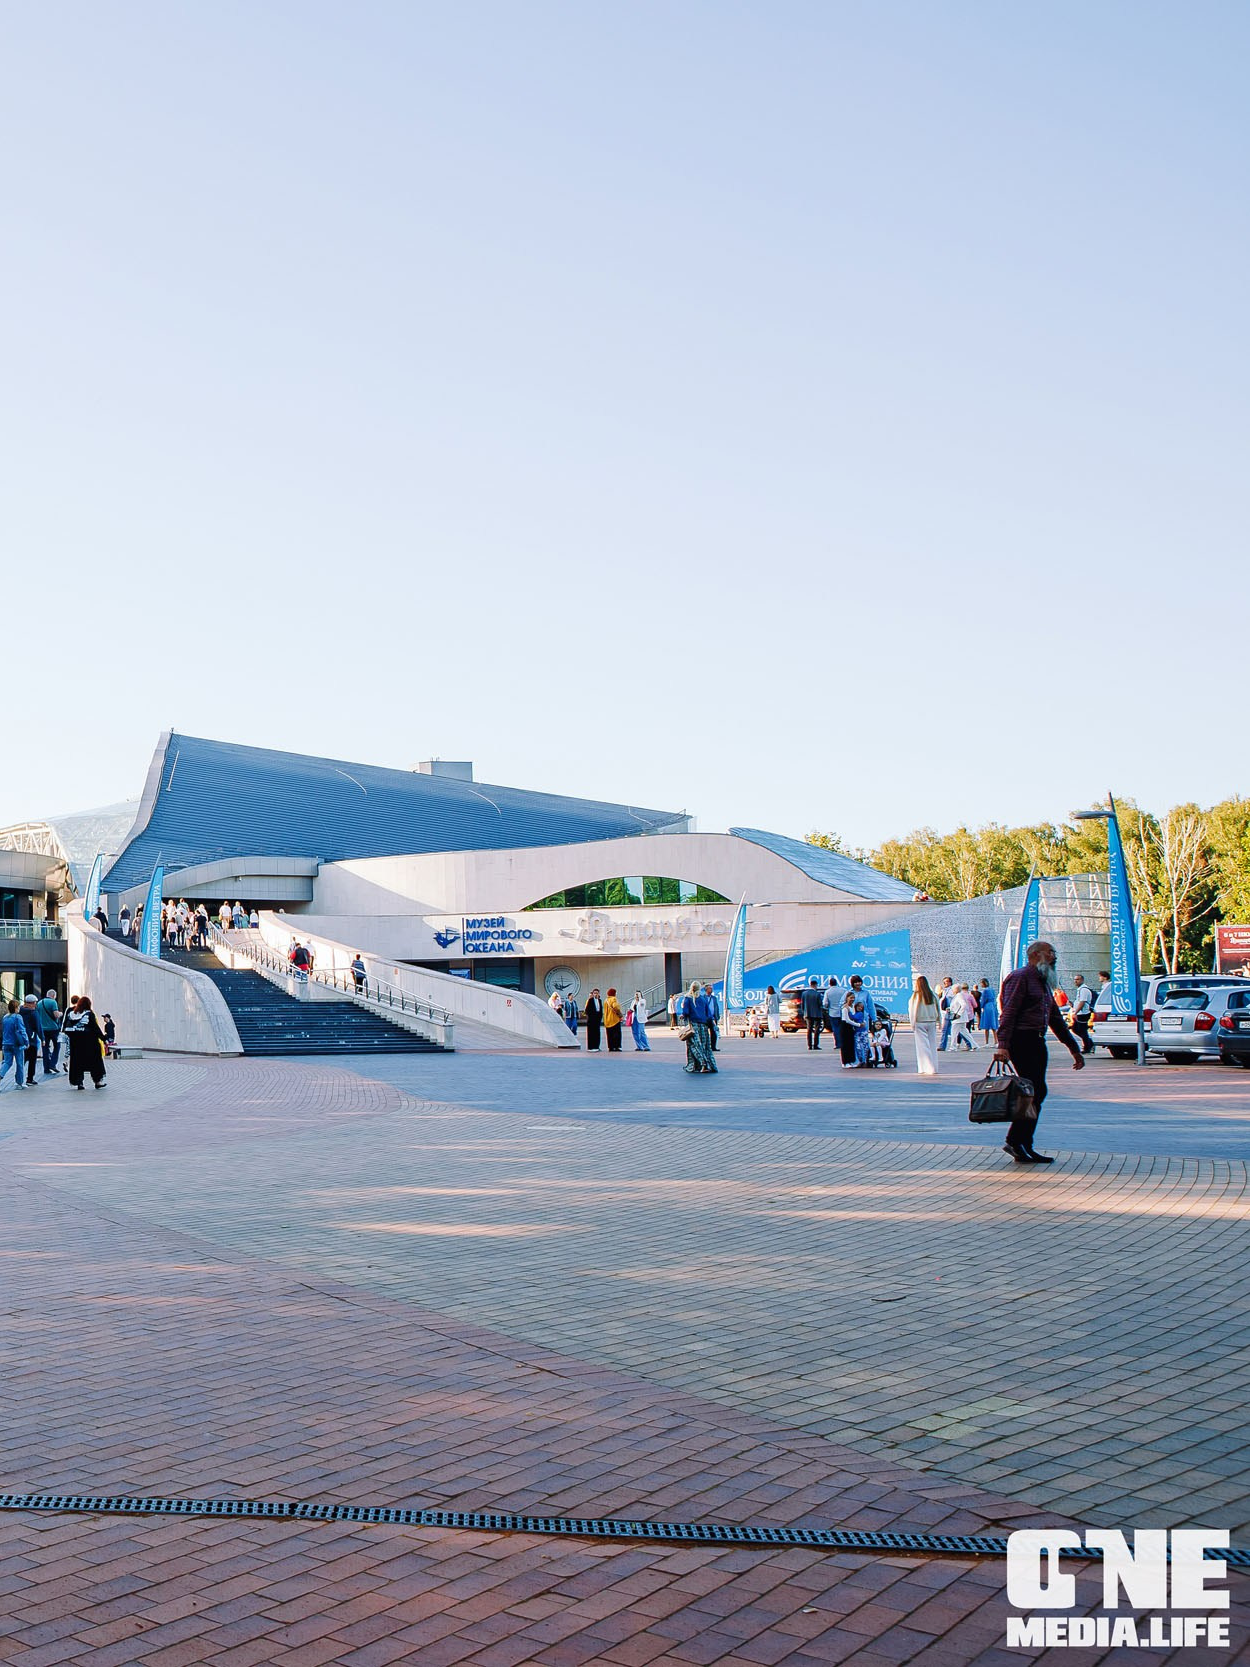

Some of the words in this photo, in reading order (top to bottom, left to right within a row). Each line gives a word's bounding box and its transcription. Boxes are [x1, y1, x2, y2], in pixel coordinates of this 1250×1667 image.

[465, 916, 505, 929] МУЗЕЙ
[151, 913, 159, 958] ИМФОНИЯ
[465, 928, 532, 941] МИРОВОГО
[465, 941, 515, 954] ОКЕАНА
[1111, 902, 1124, 996] СИМФОНИЯ
[743, 990, 768, 1001] ЮЛЯ
